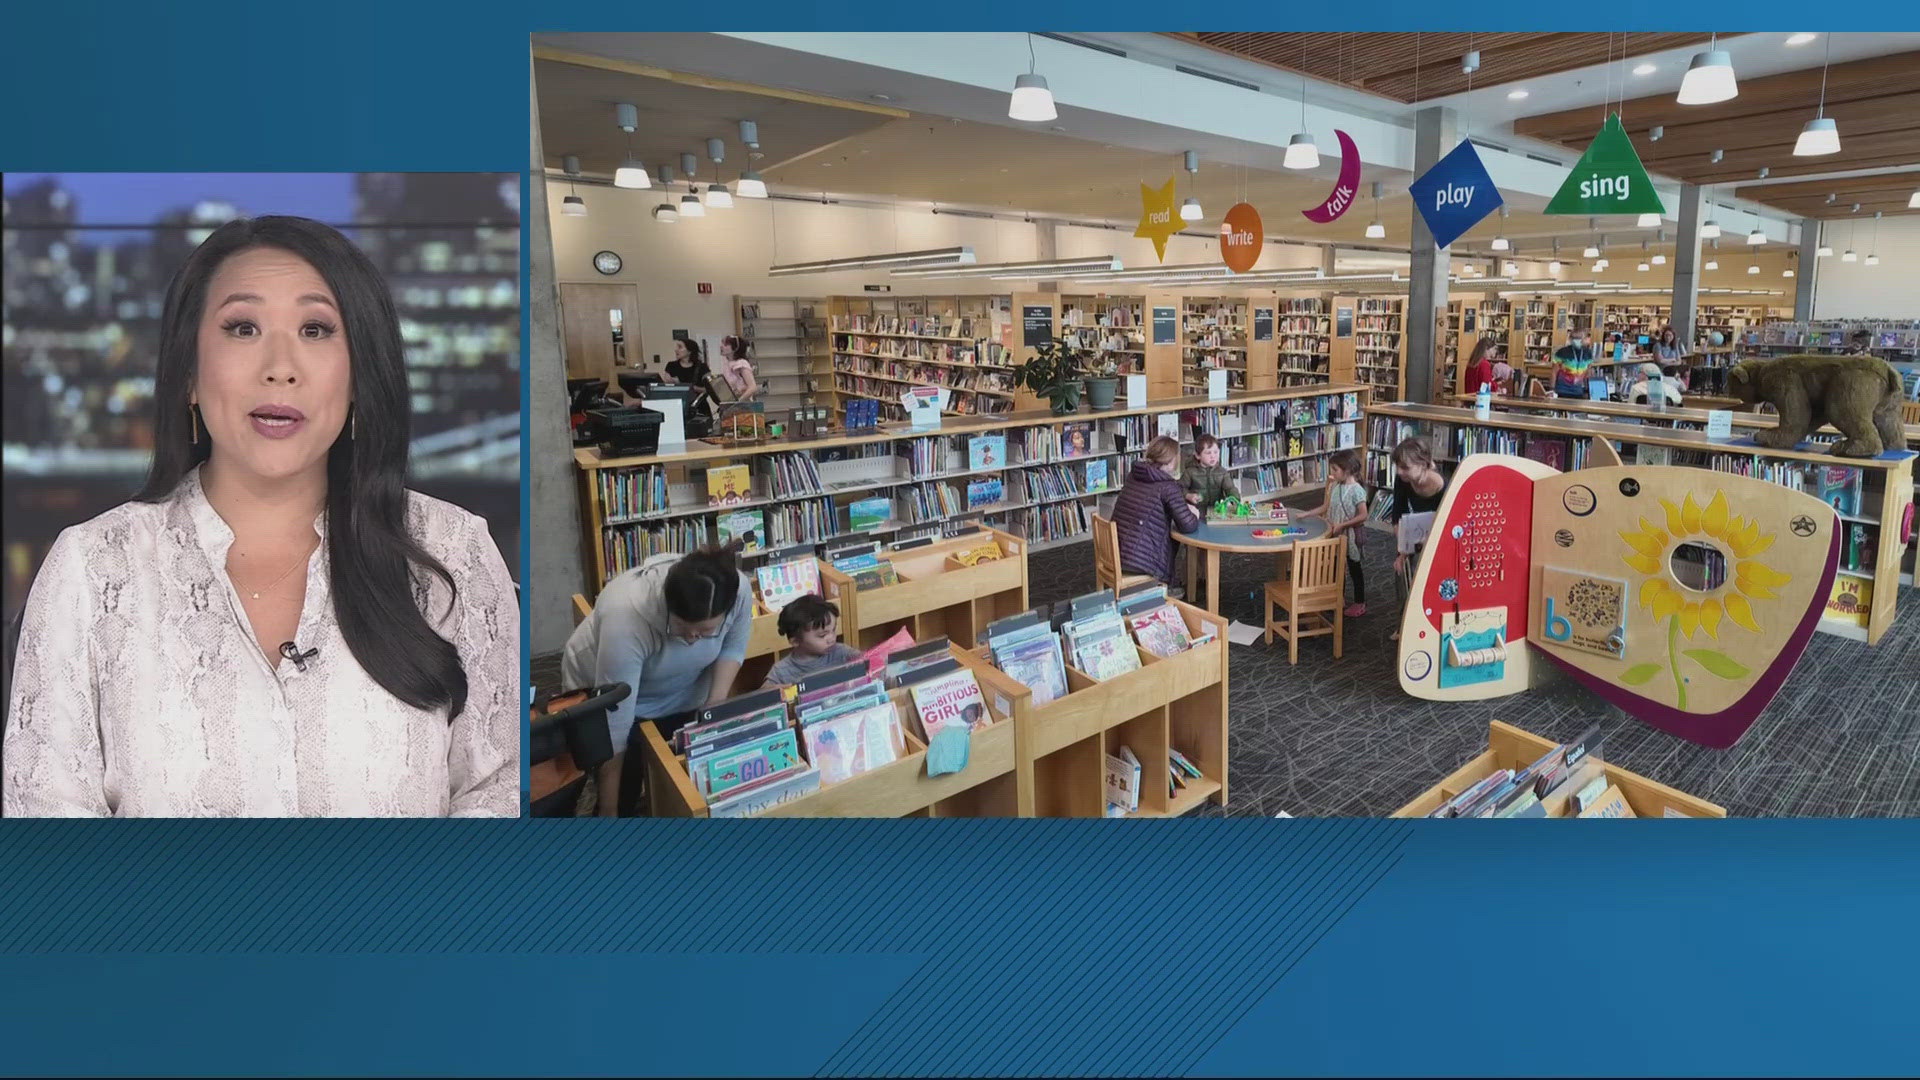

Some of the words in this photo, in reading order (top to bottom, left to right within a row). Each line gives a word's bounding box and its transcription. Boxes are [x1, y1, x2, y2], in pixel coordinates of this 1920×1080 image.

[1580, 174, 1630, 200] sing
[1326, 184, 1353, 217] talk
[1436, 183, 1475, 211] play
[1149, 207, 1170, 225] read
[1226, 229, 1253, 247] write
[1841, 581, 1859, 593] I'M
[1545, 597, 1572, 642] b
[799, 682, 806, 692] H
[703, 711, 712, 720] G
[925, 703, 963, 723] GIRL
